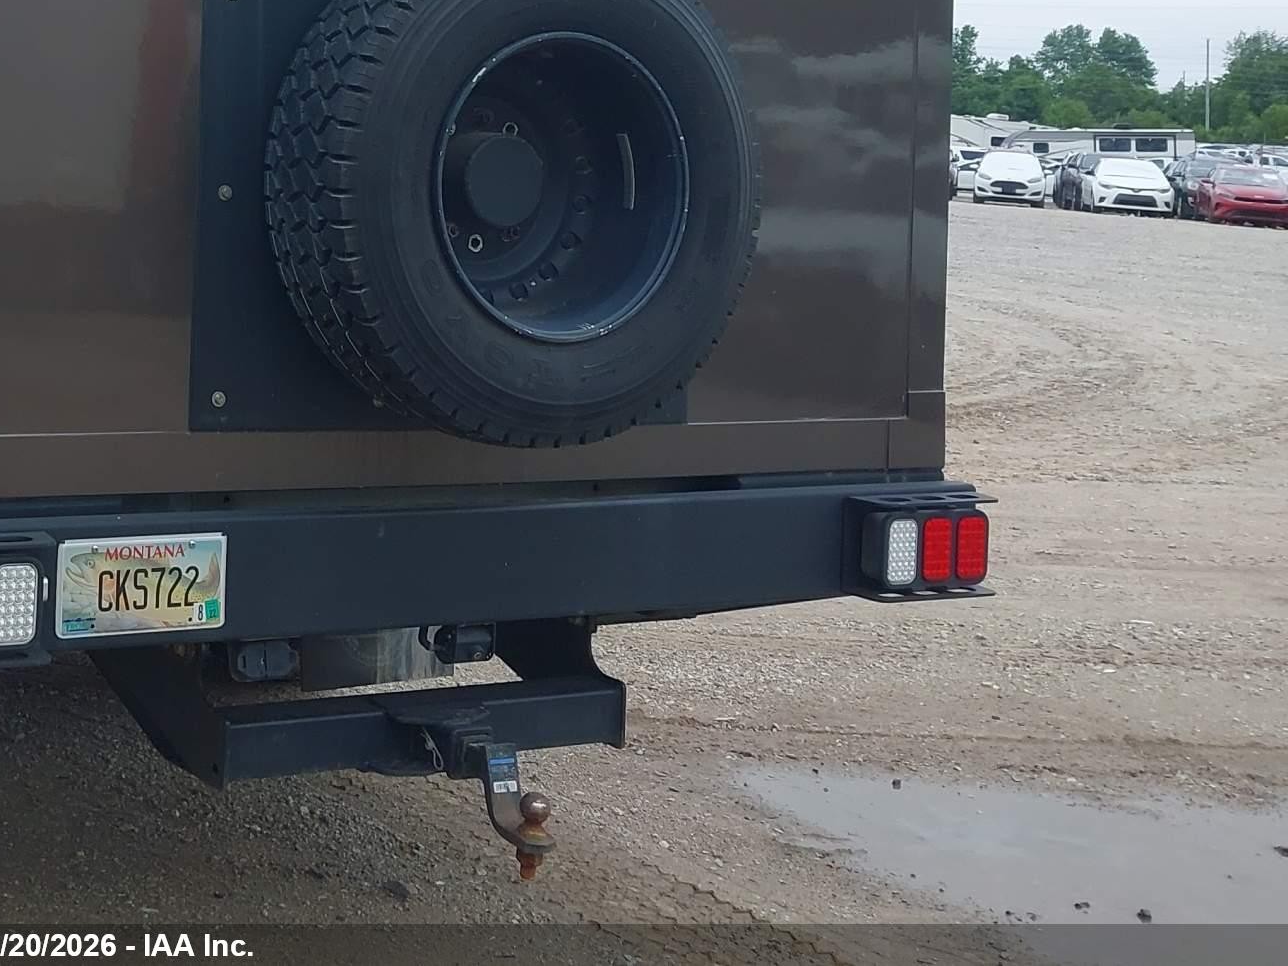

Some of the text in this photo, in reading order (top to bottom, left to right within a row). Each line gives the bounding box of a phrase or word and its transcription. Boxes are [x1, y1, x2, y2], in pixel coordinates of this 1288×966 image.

[104, 543, 185, 562] MONTANA
[98, 565, 200, 613] CKS722
[197, 604, 204, 621] 8
